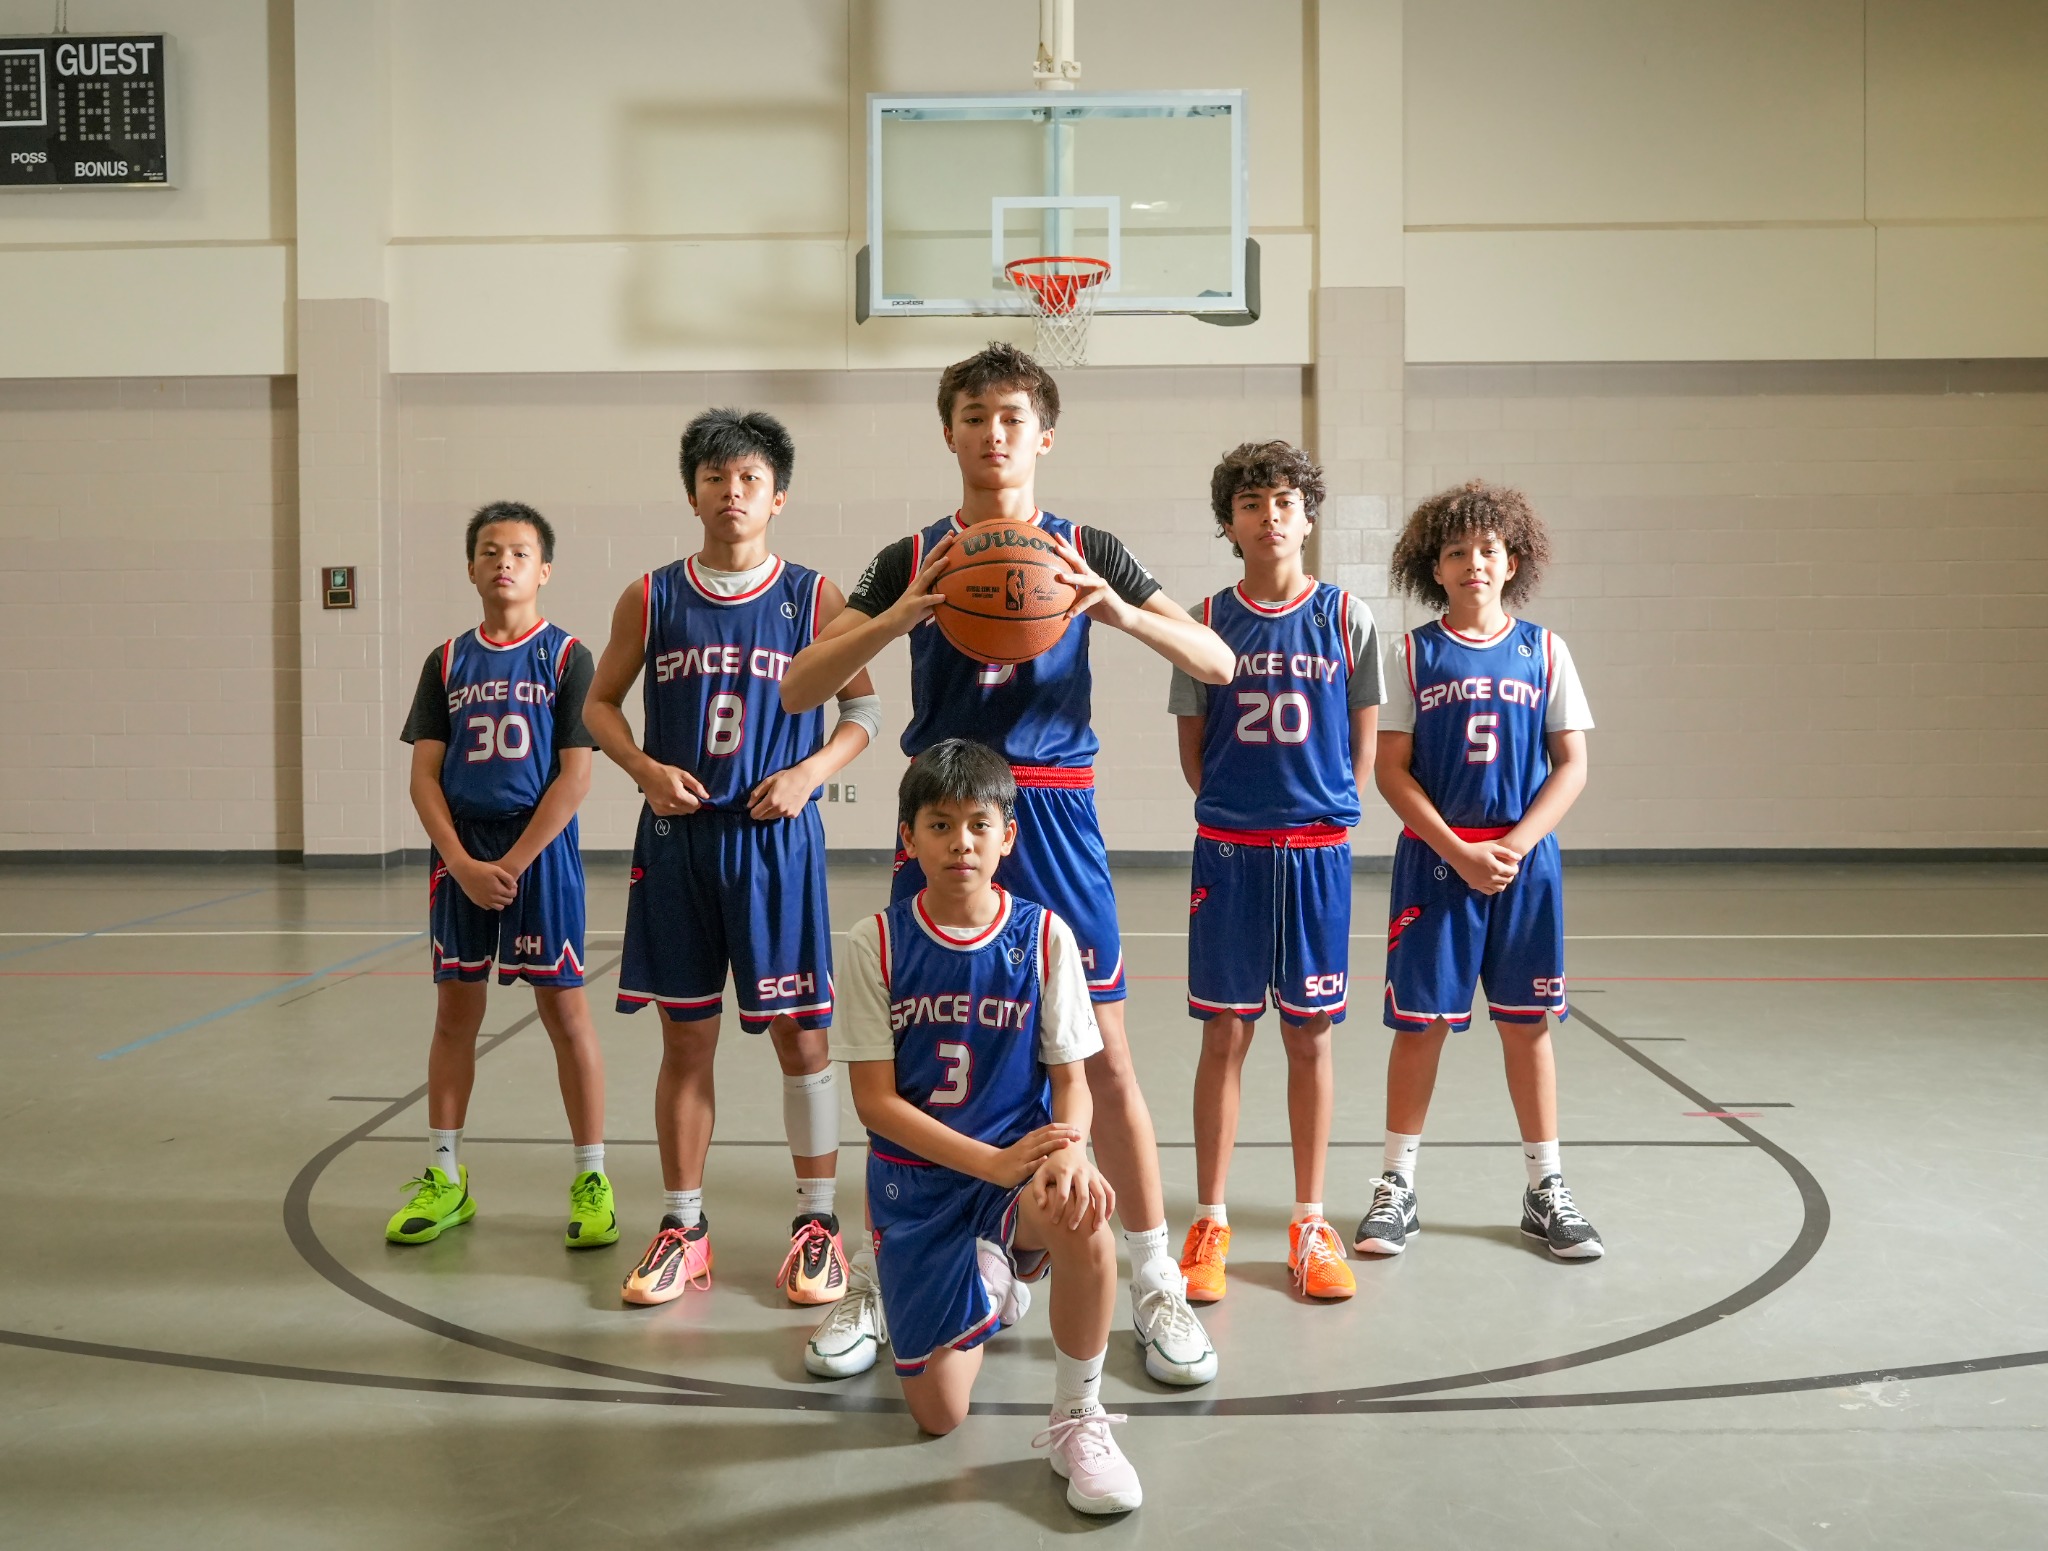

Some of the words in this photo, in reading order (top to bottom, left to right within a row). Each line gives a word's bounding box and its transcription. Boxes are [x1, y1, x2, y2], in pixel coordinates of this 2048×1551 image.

[55, 42, 156, 77] GUEST
[10, 151, 48, 164] POSS
[74, 160, 129, 178] BONUS
[655, 644, 742, 684] SPACE
[749, 647, 794, 683] CIT
[1234, 652, 1284, 678] ACE
[1291, 653, 1340, 684] CITY
[447, 679, 510, 715] SPACE
[514, 680, 556, 708] CITY
[1419, 677, 1493, 712] SPACE
[1498, 678, 1543, 710] CITY
[706, 691, 747, 758] 8
[1235, 691, 1312, 745] 20
[466, 712, 532, 763] 30
[757, 971, 816, 1001] SCH
[1305, 972, 1344, 998] SCH
[890, 994, 971, 1032] SPACE
[977, 997, 1032, 1030] CITY
[928, 1039, 975, 1107] 3
